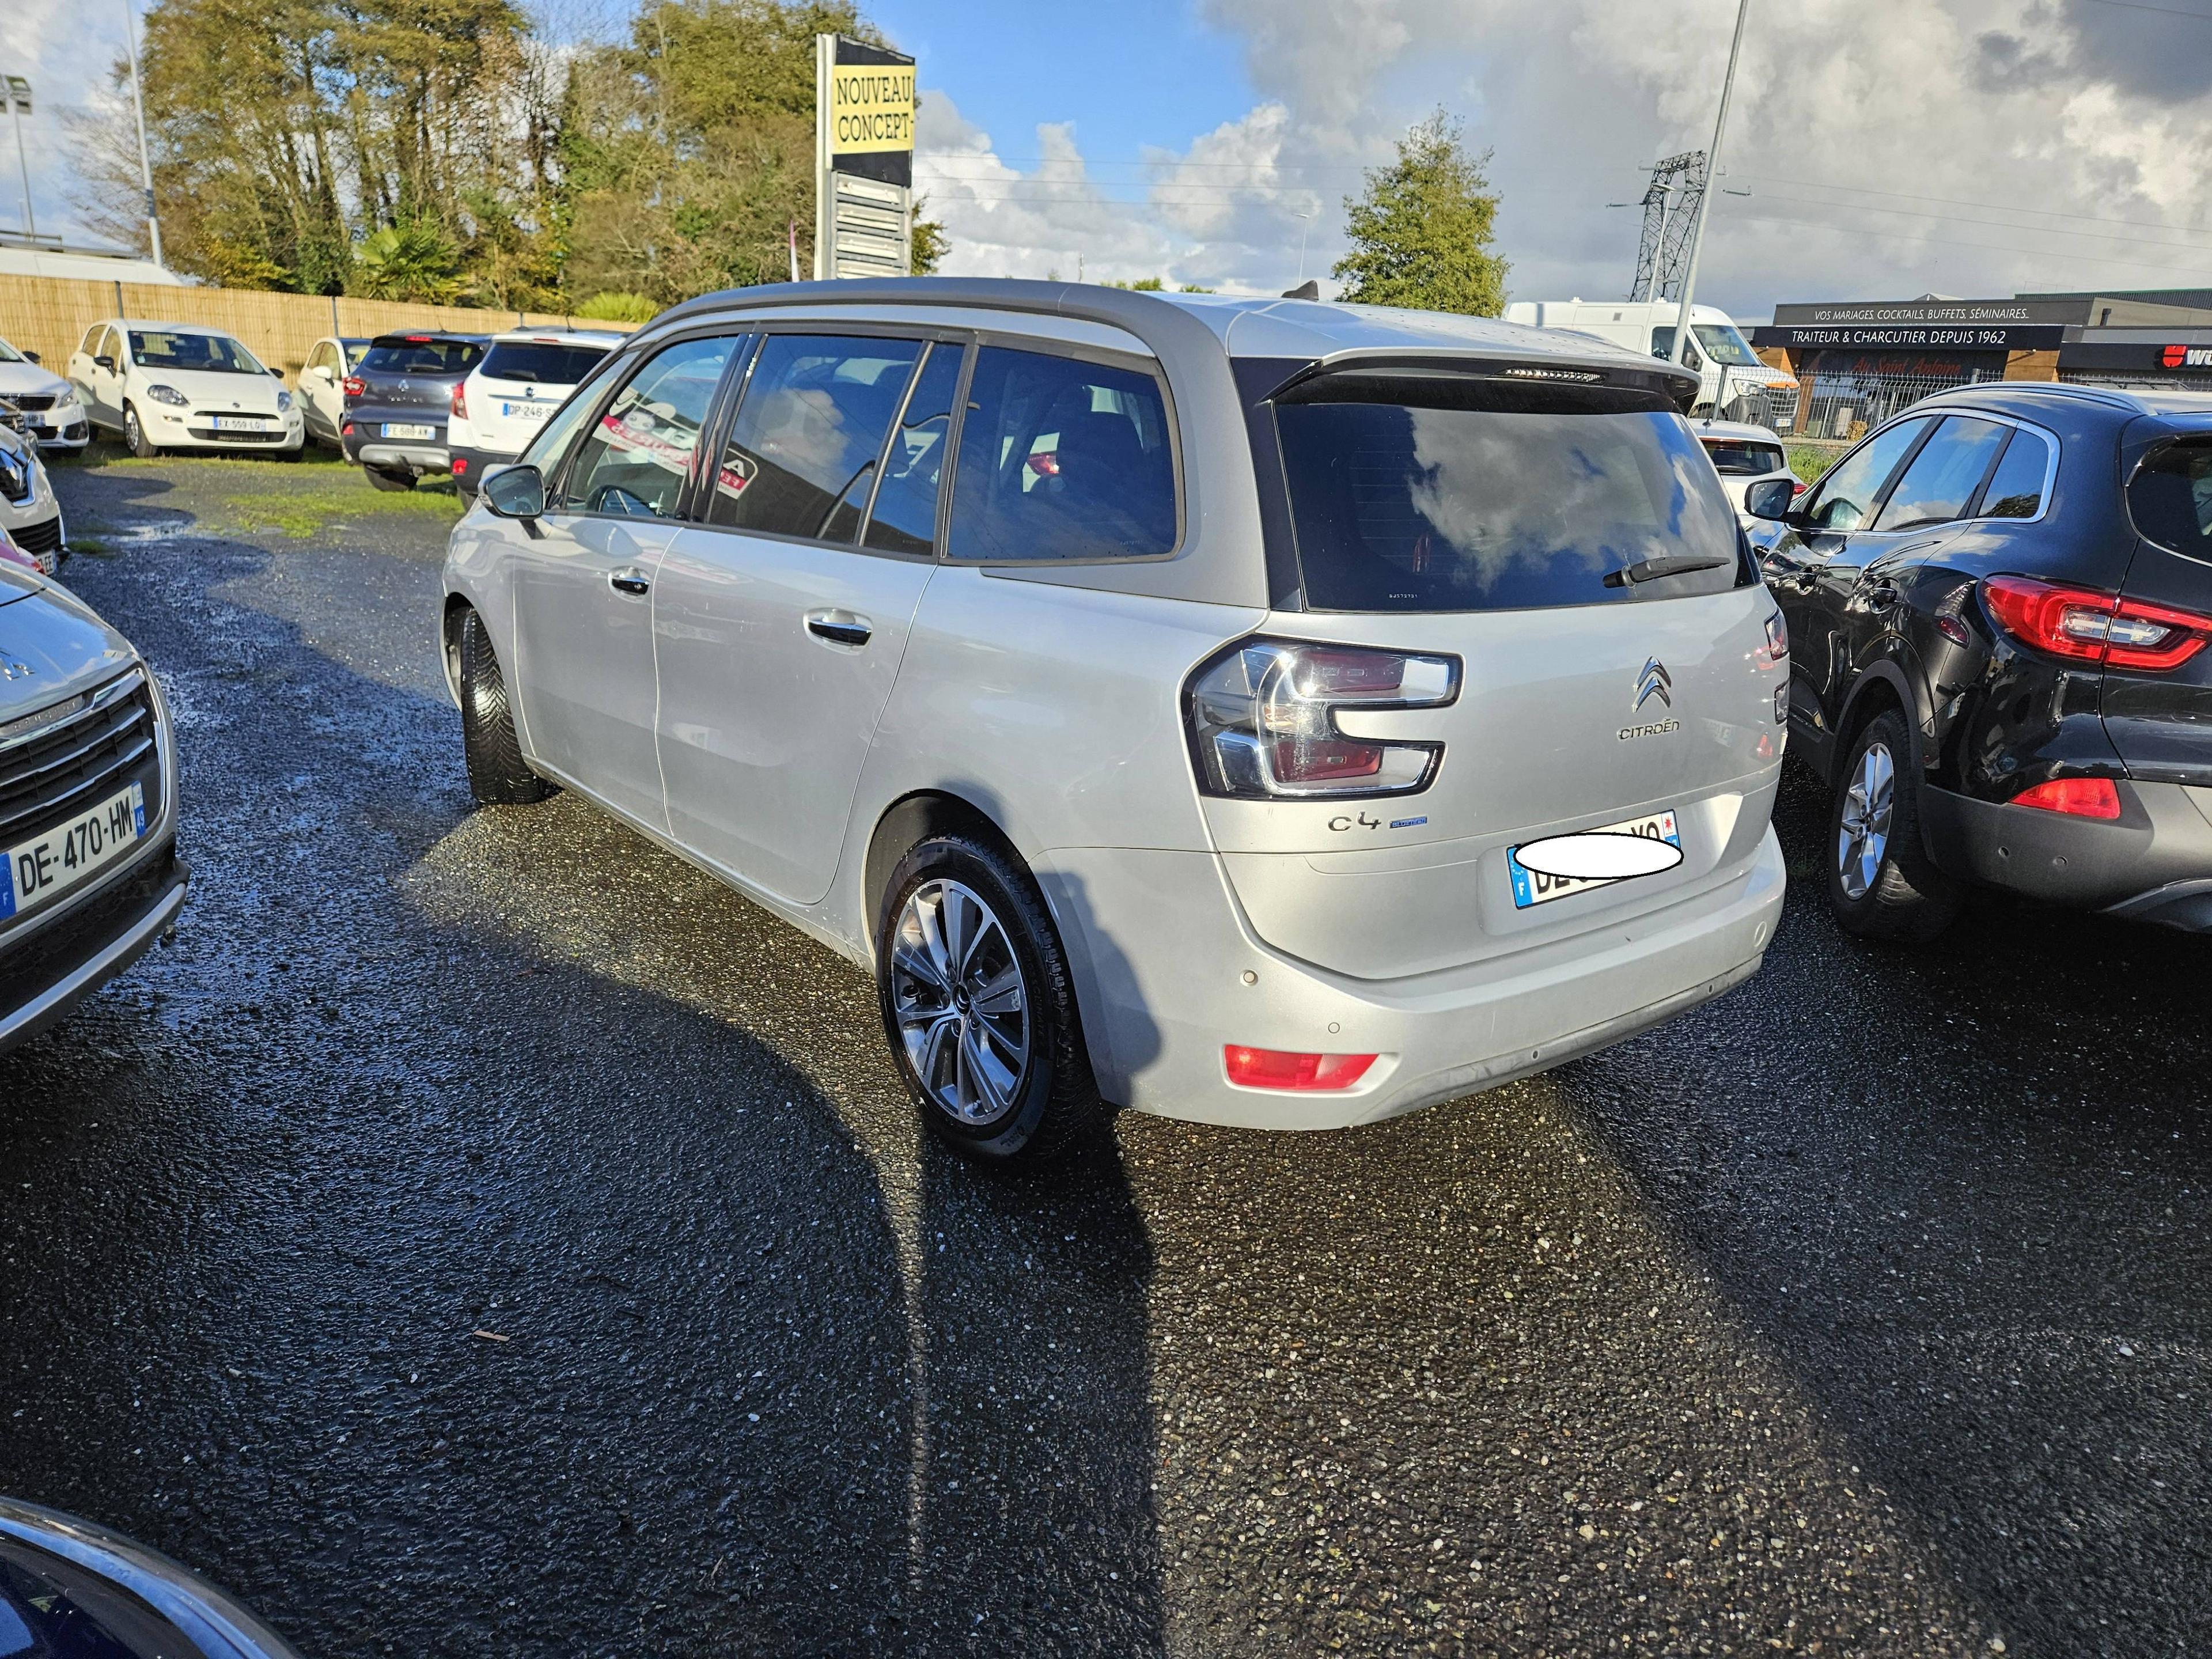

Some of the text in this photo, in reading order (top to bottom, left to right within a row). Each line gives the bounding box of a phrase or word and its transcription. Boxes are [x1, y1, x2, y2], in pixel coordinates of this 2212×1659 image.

[836, 75, 911, 105] NOUVEAU
[838, 111, 910, 142] CONCEPT
[1815, 310, 1831, 320] VOS
[1792, 330, 2006, 344] TRAITEUR & CHARCUTIER DEPUIS 1962
[137, 810, 145, 830] 49
[18, 796, 132, 897] DE-470-HM
